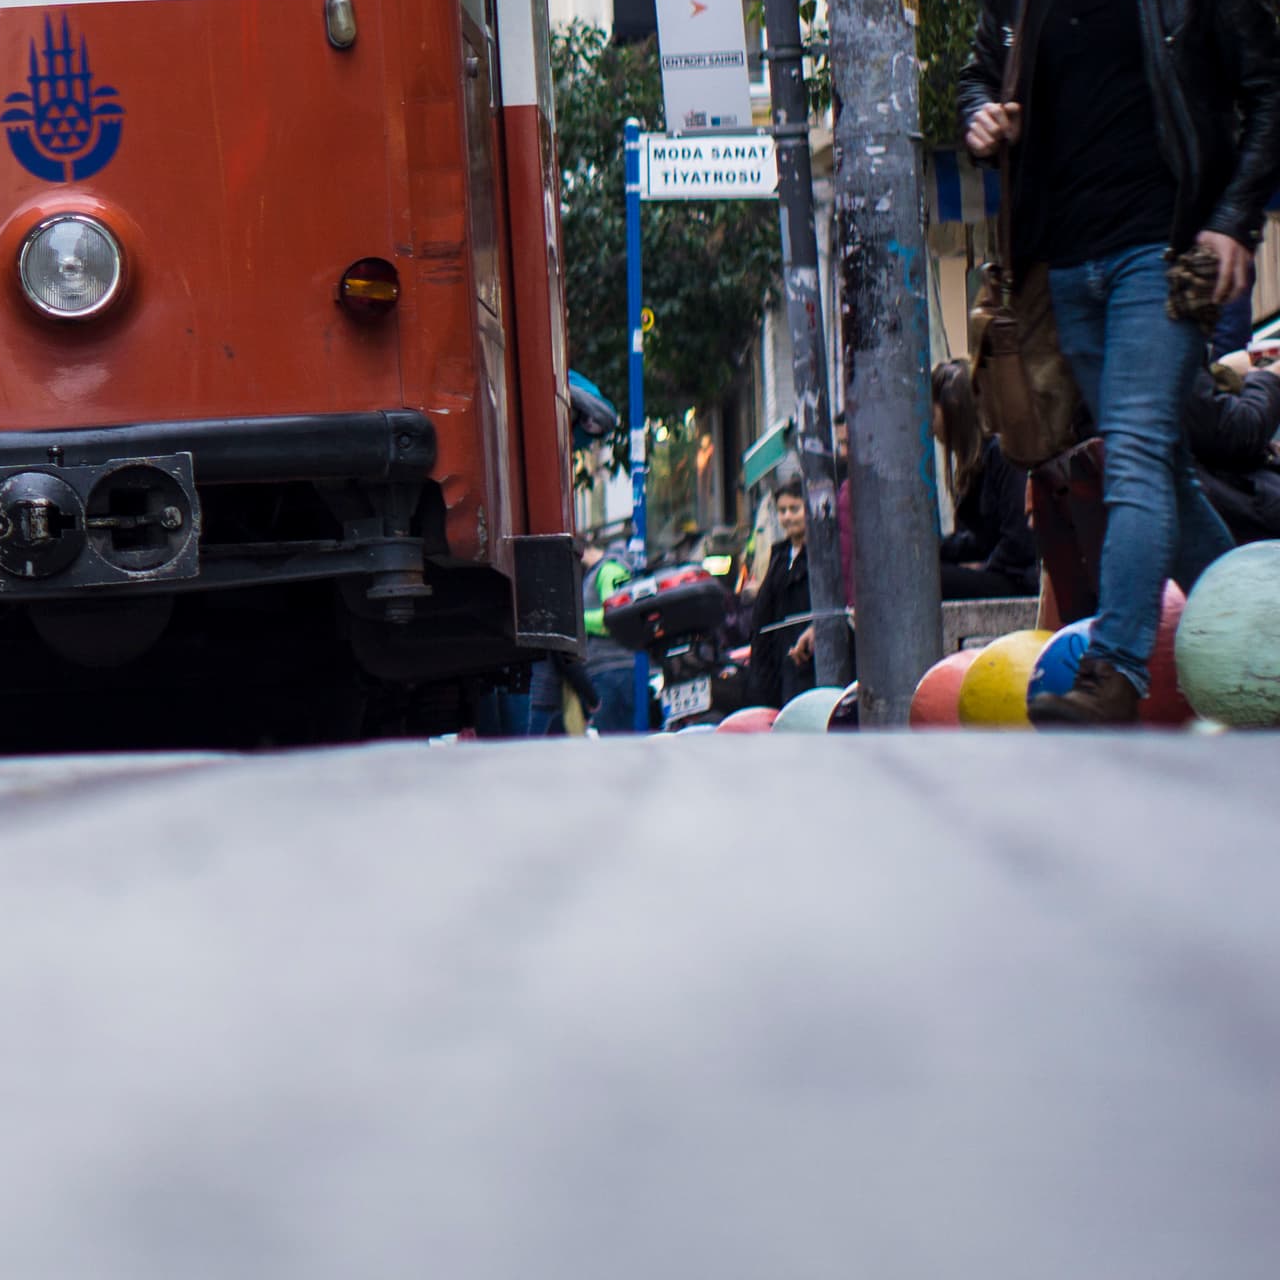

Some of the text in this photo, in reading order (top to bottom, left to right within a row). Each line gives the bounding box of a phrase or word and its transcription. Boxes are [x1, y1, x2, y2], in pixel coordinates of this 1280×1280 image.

[653, 144, 768, 160] MODA SANAT
[662, 166, 761, 185] TİYATROSU
